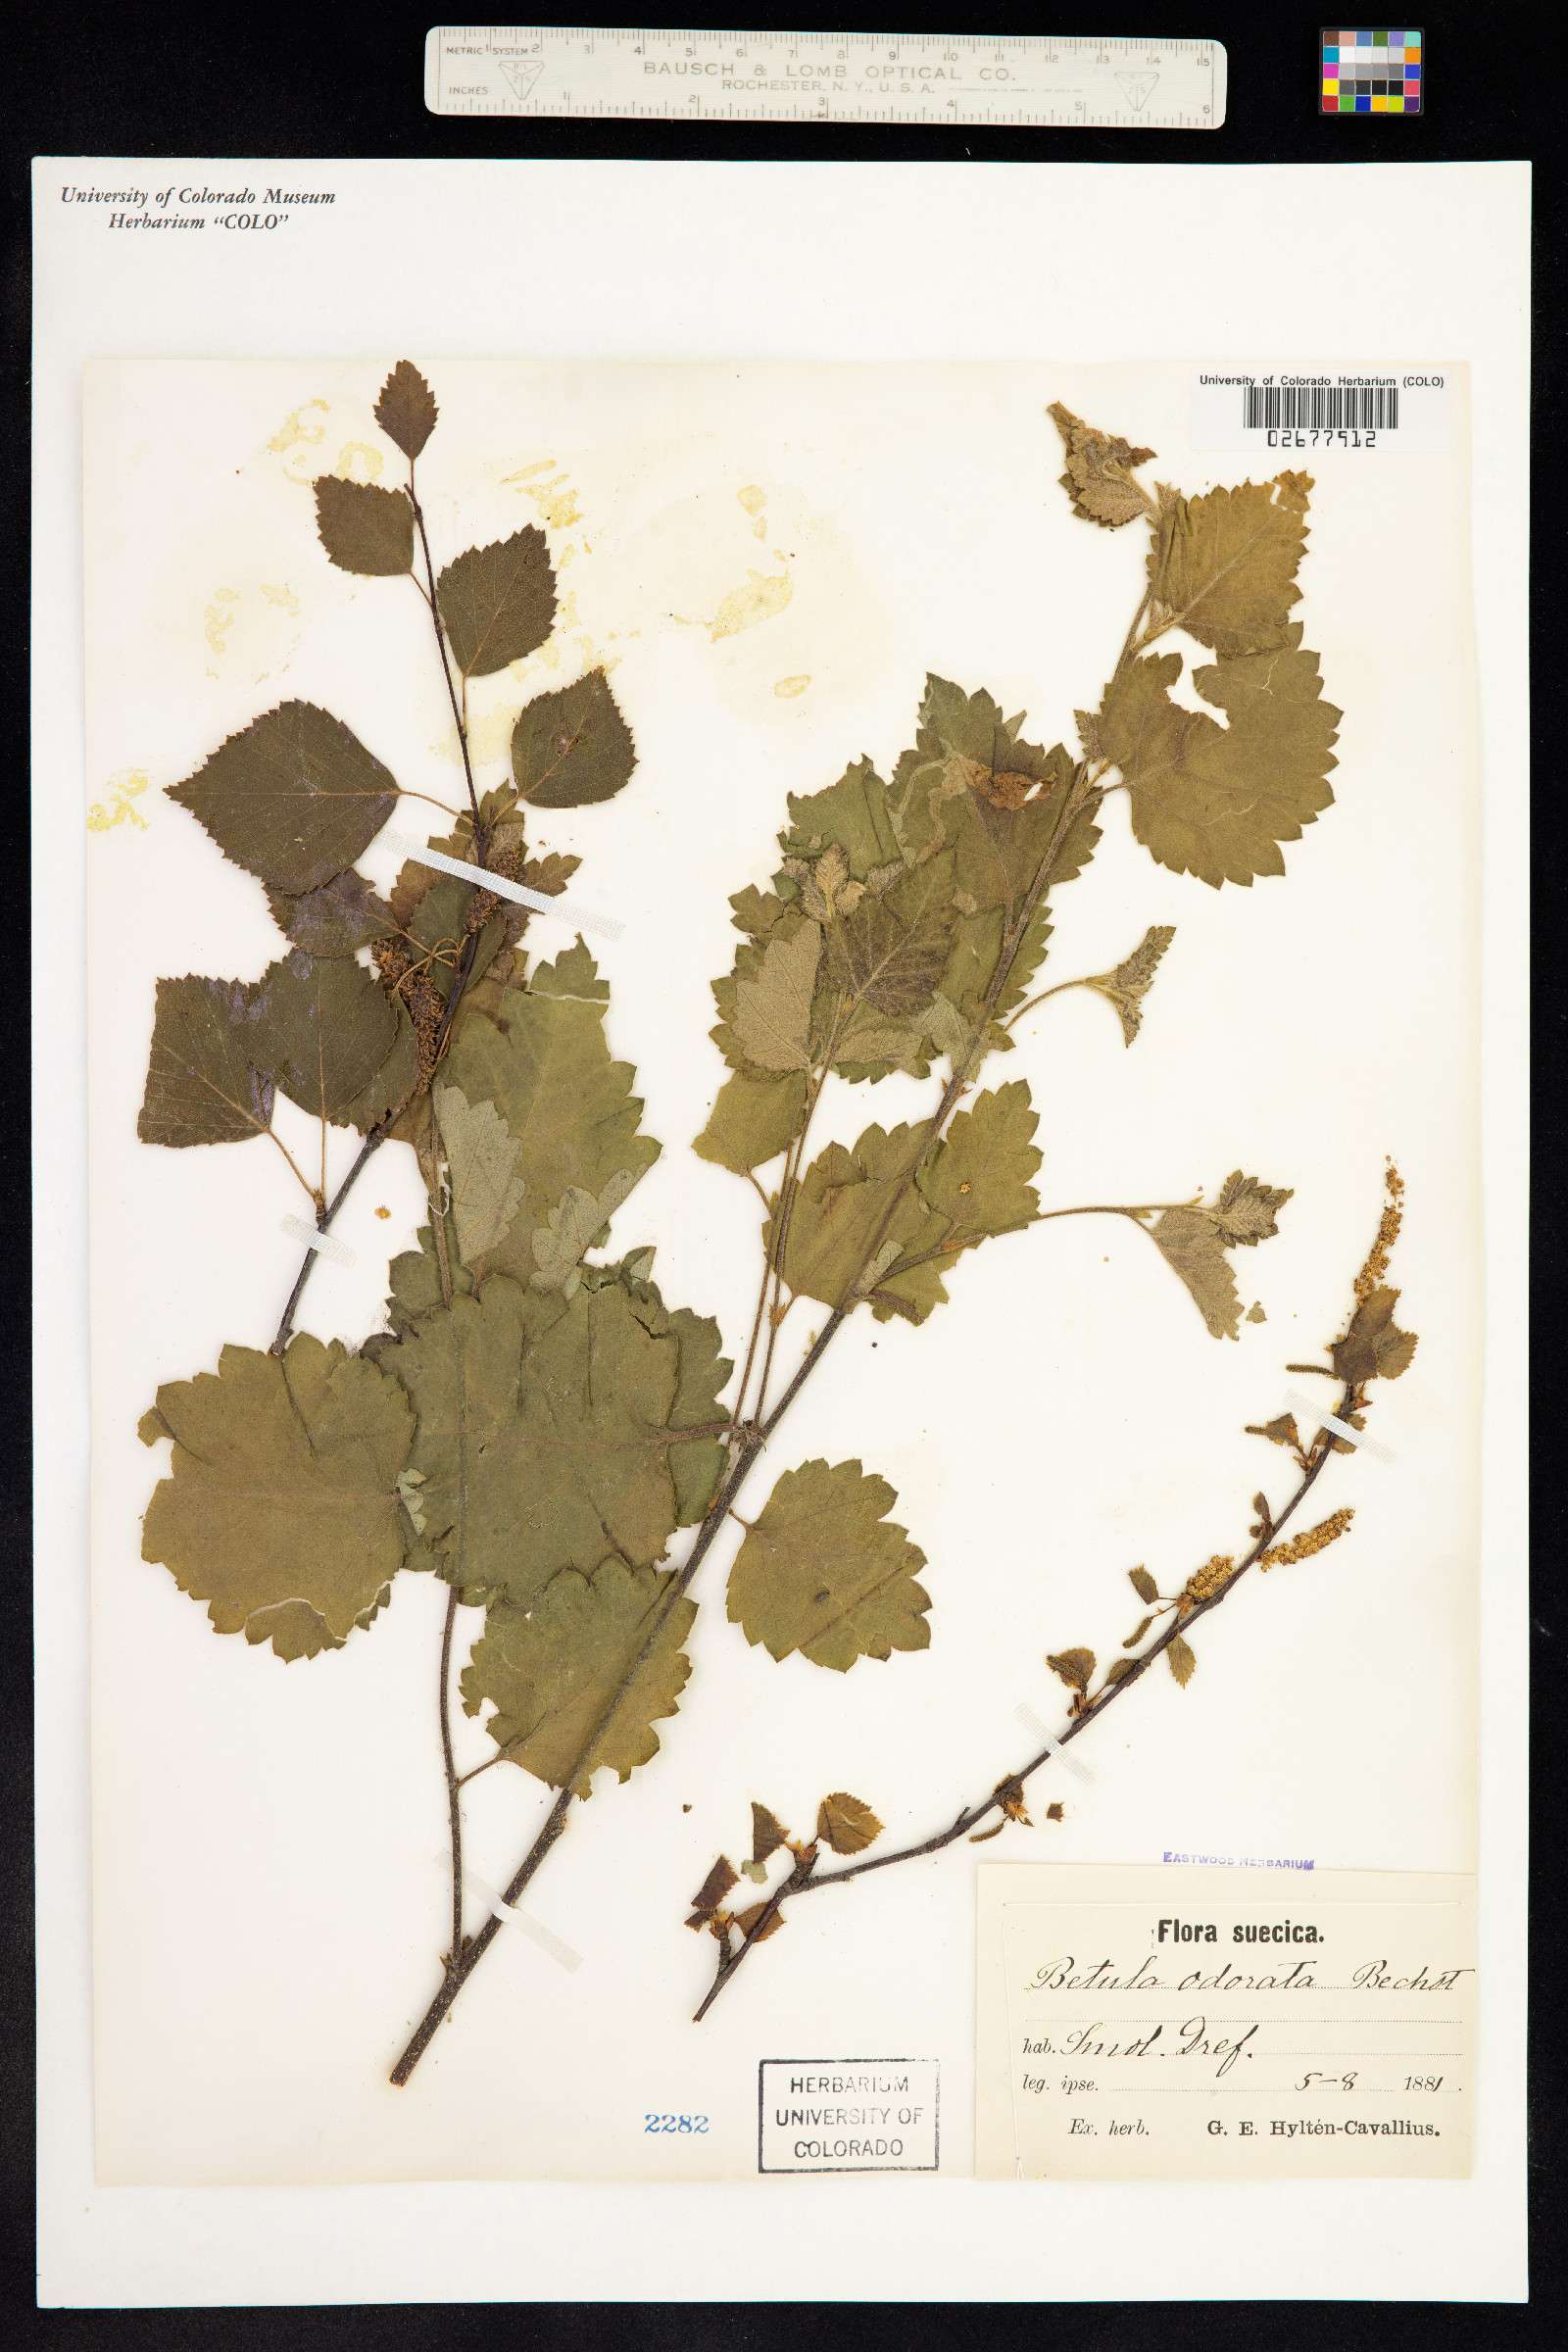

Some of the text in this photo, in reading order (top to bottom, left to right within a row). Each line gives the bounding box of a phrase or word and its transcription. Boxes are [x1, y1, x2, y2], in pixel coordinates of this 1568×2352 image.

[446, 46, 483, 55] METRIC
[532, 44, 540, 53] 2
[583, 45, 591, 54] 3
[634, 46, 642, 55] 4
[685, 47, 693, 56] 5
[736, 48, 744, 57] 6
[788, 49, 795, 58] 7
[837, 50, 846, 59] 8
[889, 51, 897, 60] 9
[944, 52, 958, 61] 10
[1046, 54, 1059, 63] 12
[1096, 55, 1110, 64] 13
[1147, 56, 1161, 65] 14
[1197, 57, 1210, 67] 15
[644, 62, 1015, 81] BAUSCH & LOMB OPTICAL CO.
[449, 86, 488, 95] INCHES
[818, 97, 825, 106] 3
[947, 99, 955, 108] 4
[1075, 102, 1083, 111] 5
[1202, 105, 1210, 114] 6
[61, 186, 336, 208] University of Colorado Museum
[109, 213, 289, 229] Herbarium “COLO”
[1200, 375, 1445, 388] University of Colorado Herbarium (COLO)
[1267, 429, 1376, 447] 02677912
[1163, 1851, 1235, 1866] EASTWOOD
[1157, 1919, 1325, 1943] Flora suecica.
[1036, 1955, 1166, 1990] Betula
[1178, 1960, 1317, 1991] odorata
[1022, 2037, 1055, 2054] hab.
[790, 2076, 909, 2093] HERBARIUM
[1022, 2075, 1099, 2095] leg. ipse.
[1403, 2076, 1444, 2092] 1881
[644, 2113, 710, 2133] 2282
[775, 2107, 924, 2126] UNIVERSITY OF
[1068, 2118, 1441, 2138] Ex. herb. G. E. Hyltén-Cavallius.
[794, 2138, 904, 2158] COLORADO
